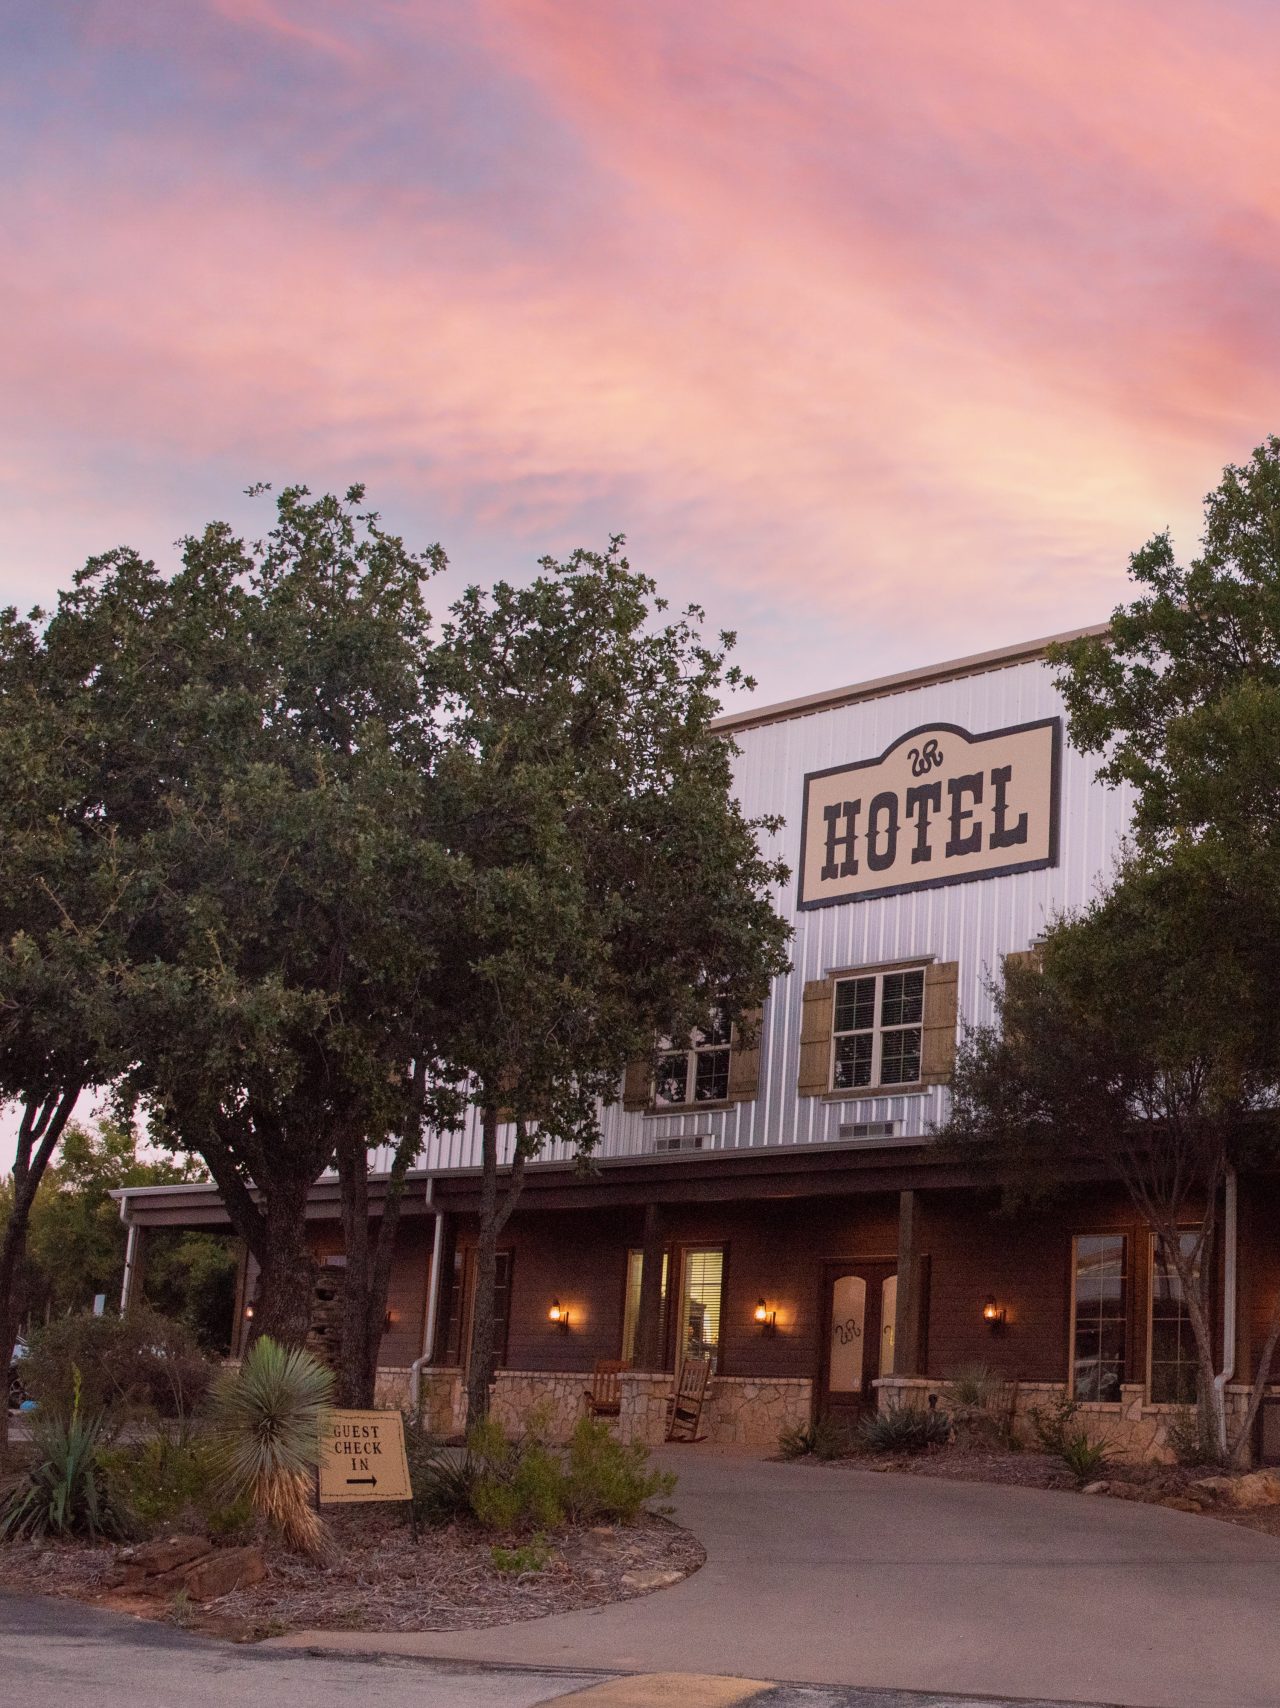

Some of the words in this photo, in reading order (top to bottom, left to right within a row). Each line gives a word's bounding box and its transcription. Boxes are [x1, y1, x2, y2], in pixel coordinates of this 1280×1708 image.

[821, 765, 1028, 881] HOTEL
[334, 1425, 379, 1438] GUEST
[335, 1442, 382, 1454] CHECK
[352, 1458, 369, 1471] IN
